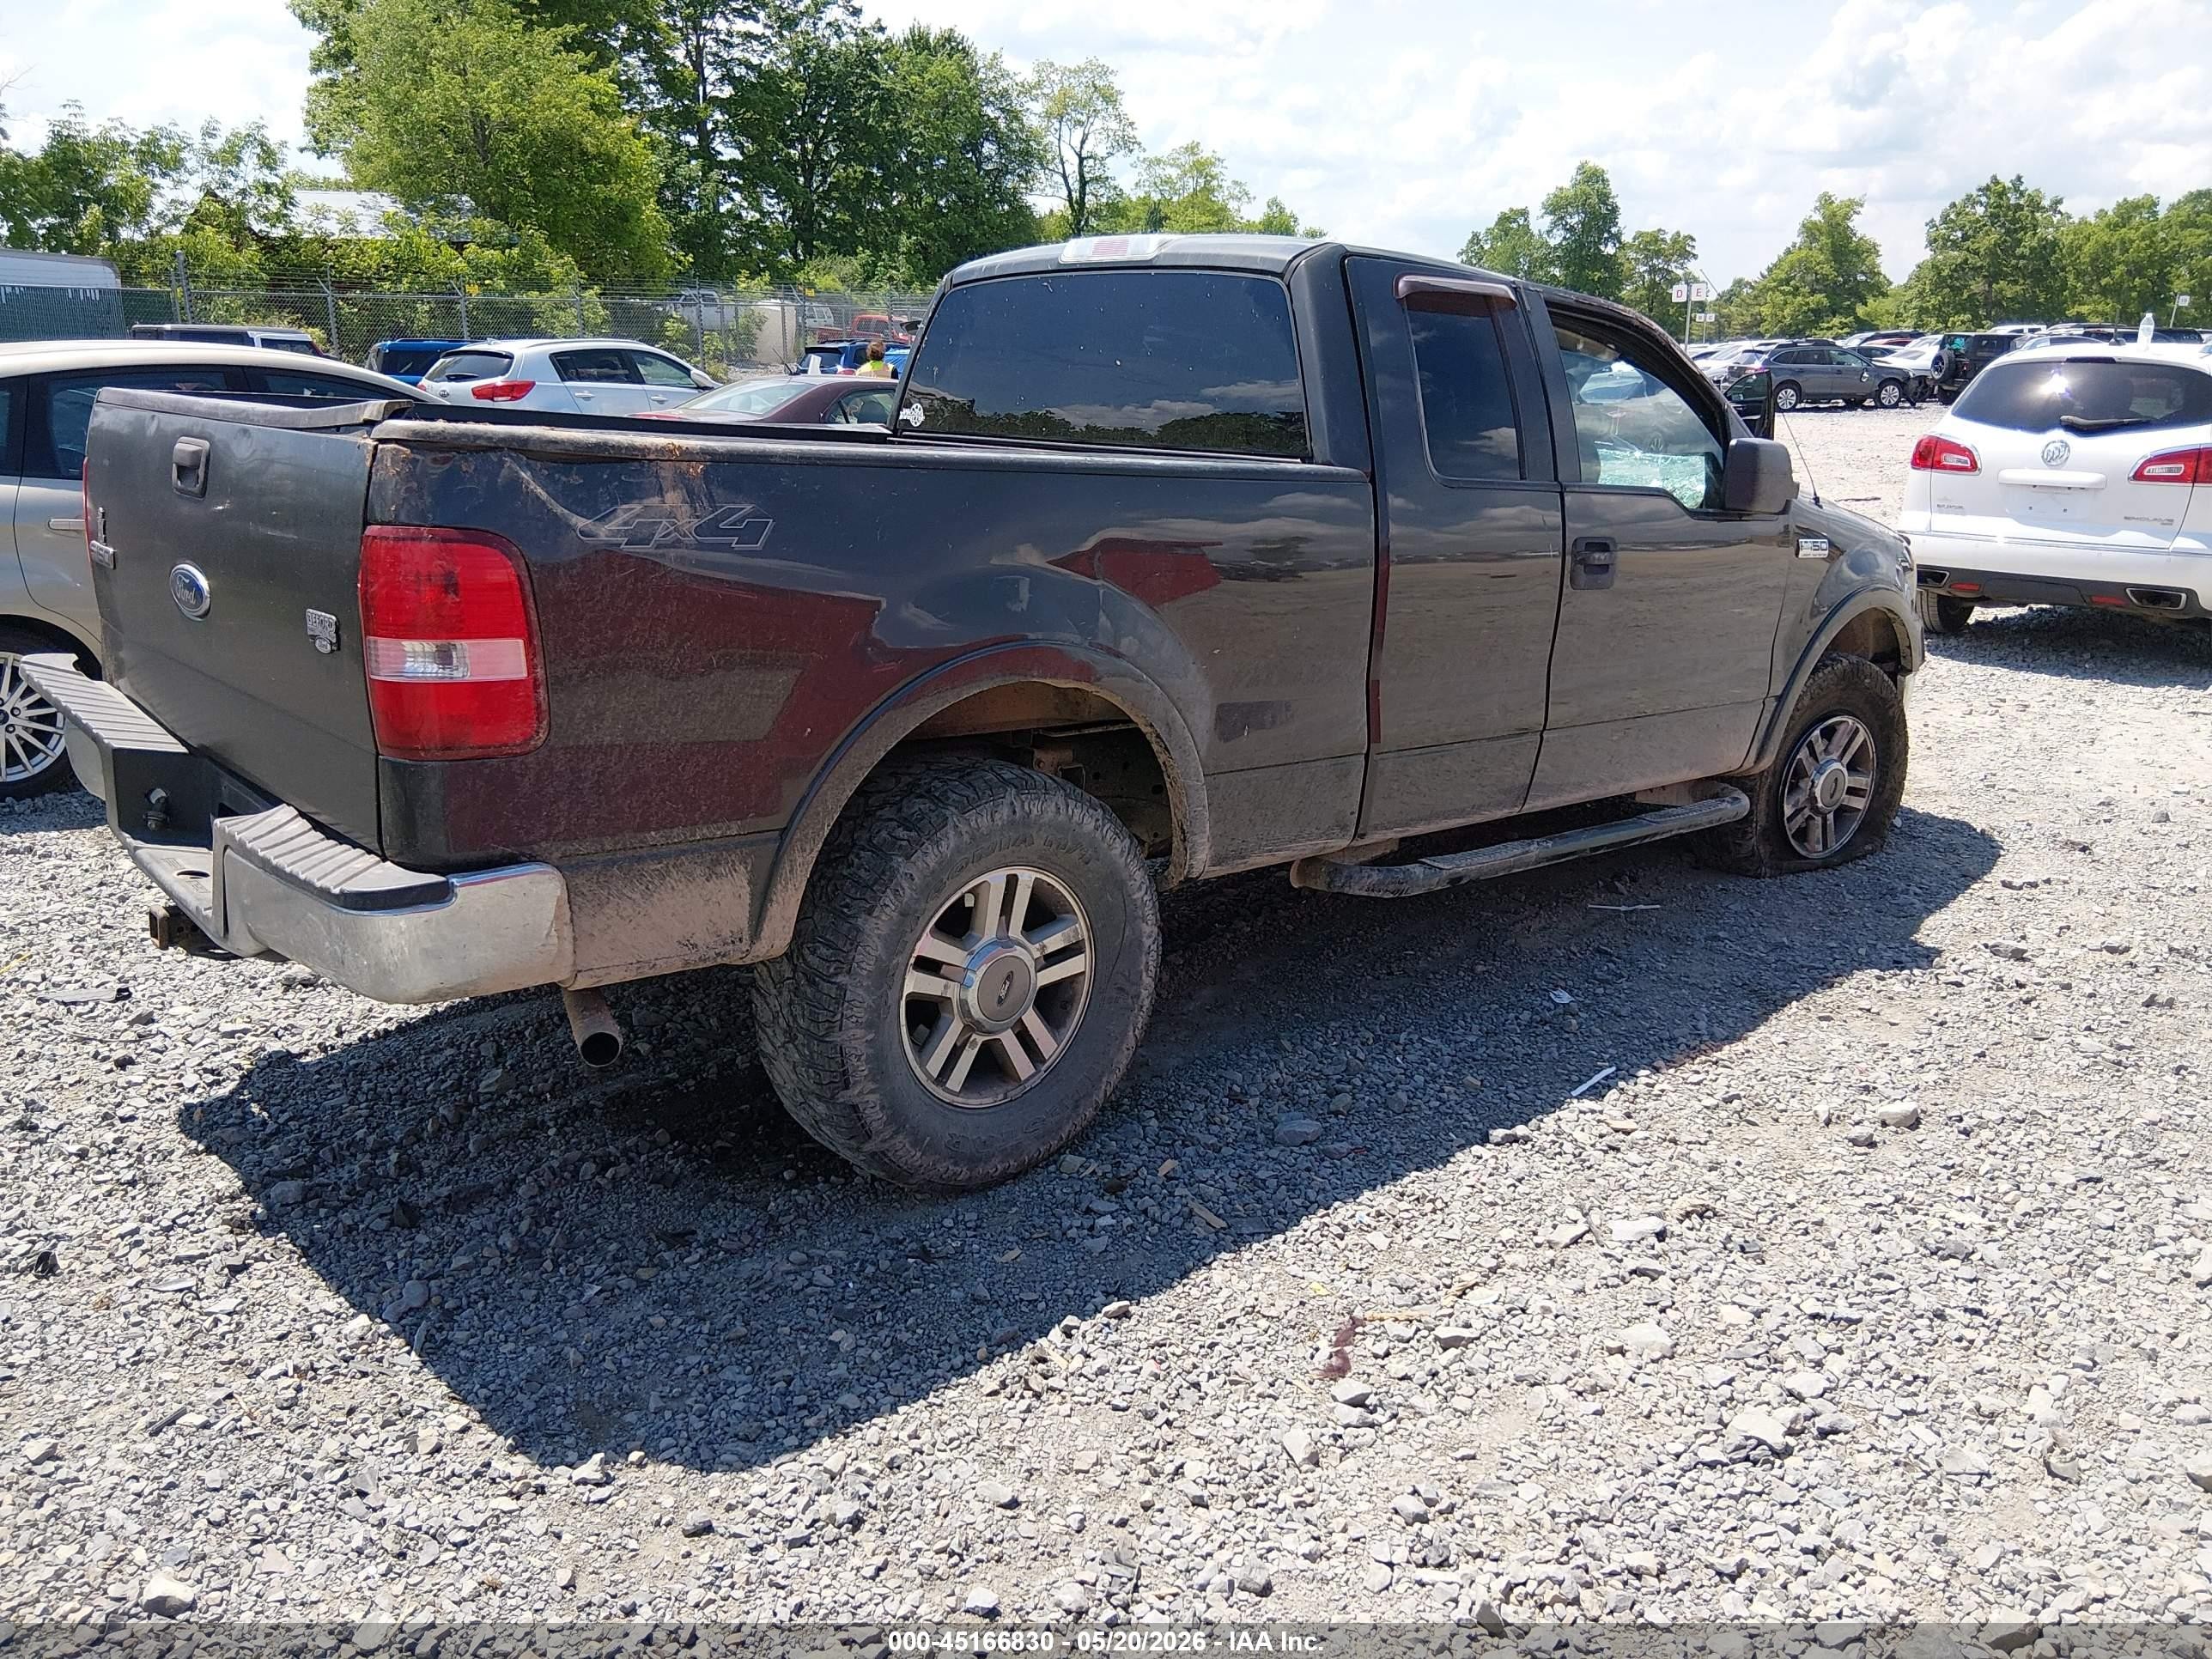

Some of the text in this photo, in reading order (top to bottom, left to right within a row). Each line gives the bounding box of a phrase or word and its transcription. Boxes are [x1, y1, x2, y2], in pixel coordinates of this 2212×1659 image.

[1676, 289, 1683, 298] D
[1696, 288, 1702, 297] E
[175, 574, 197, 605] Ford
